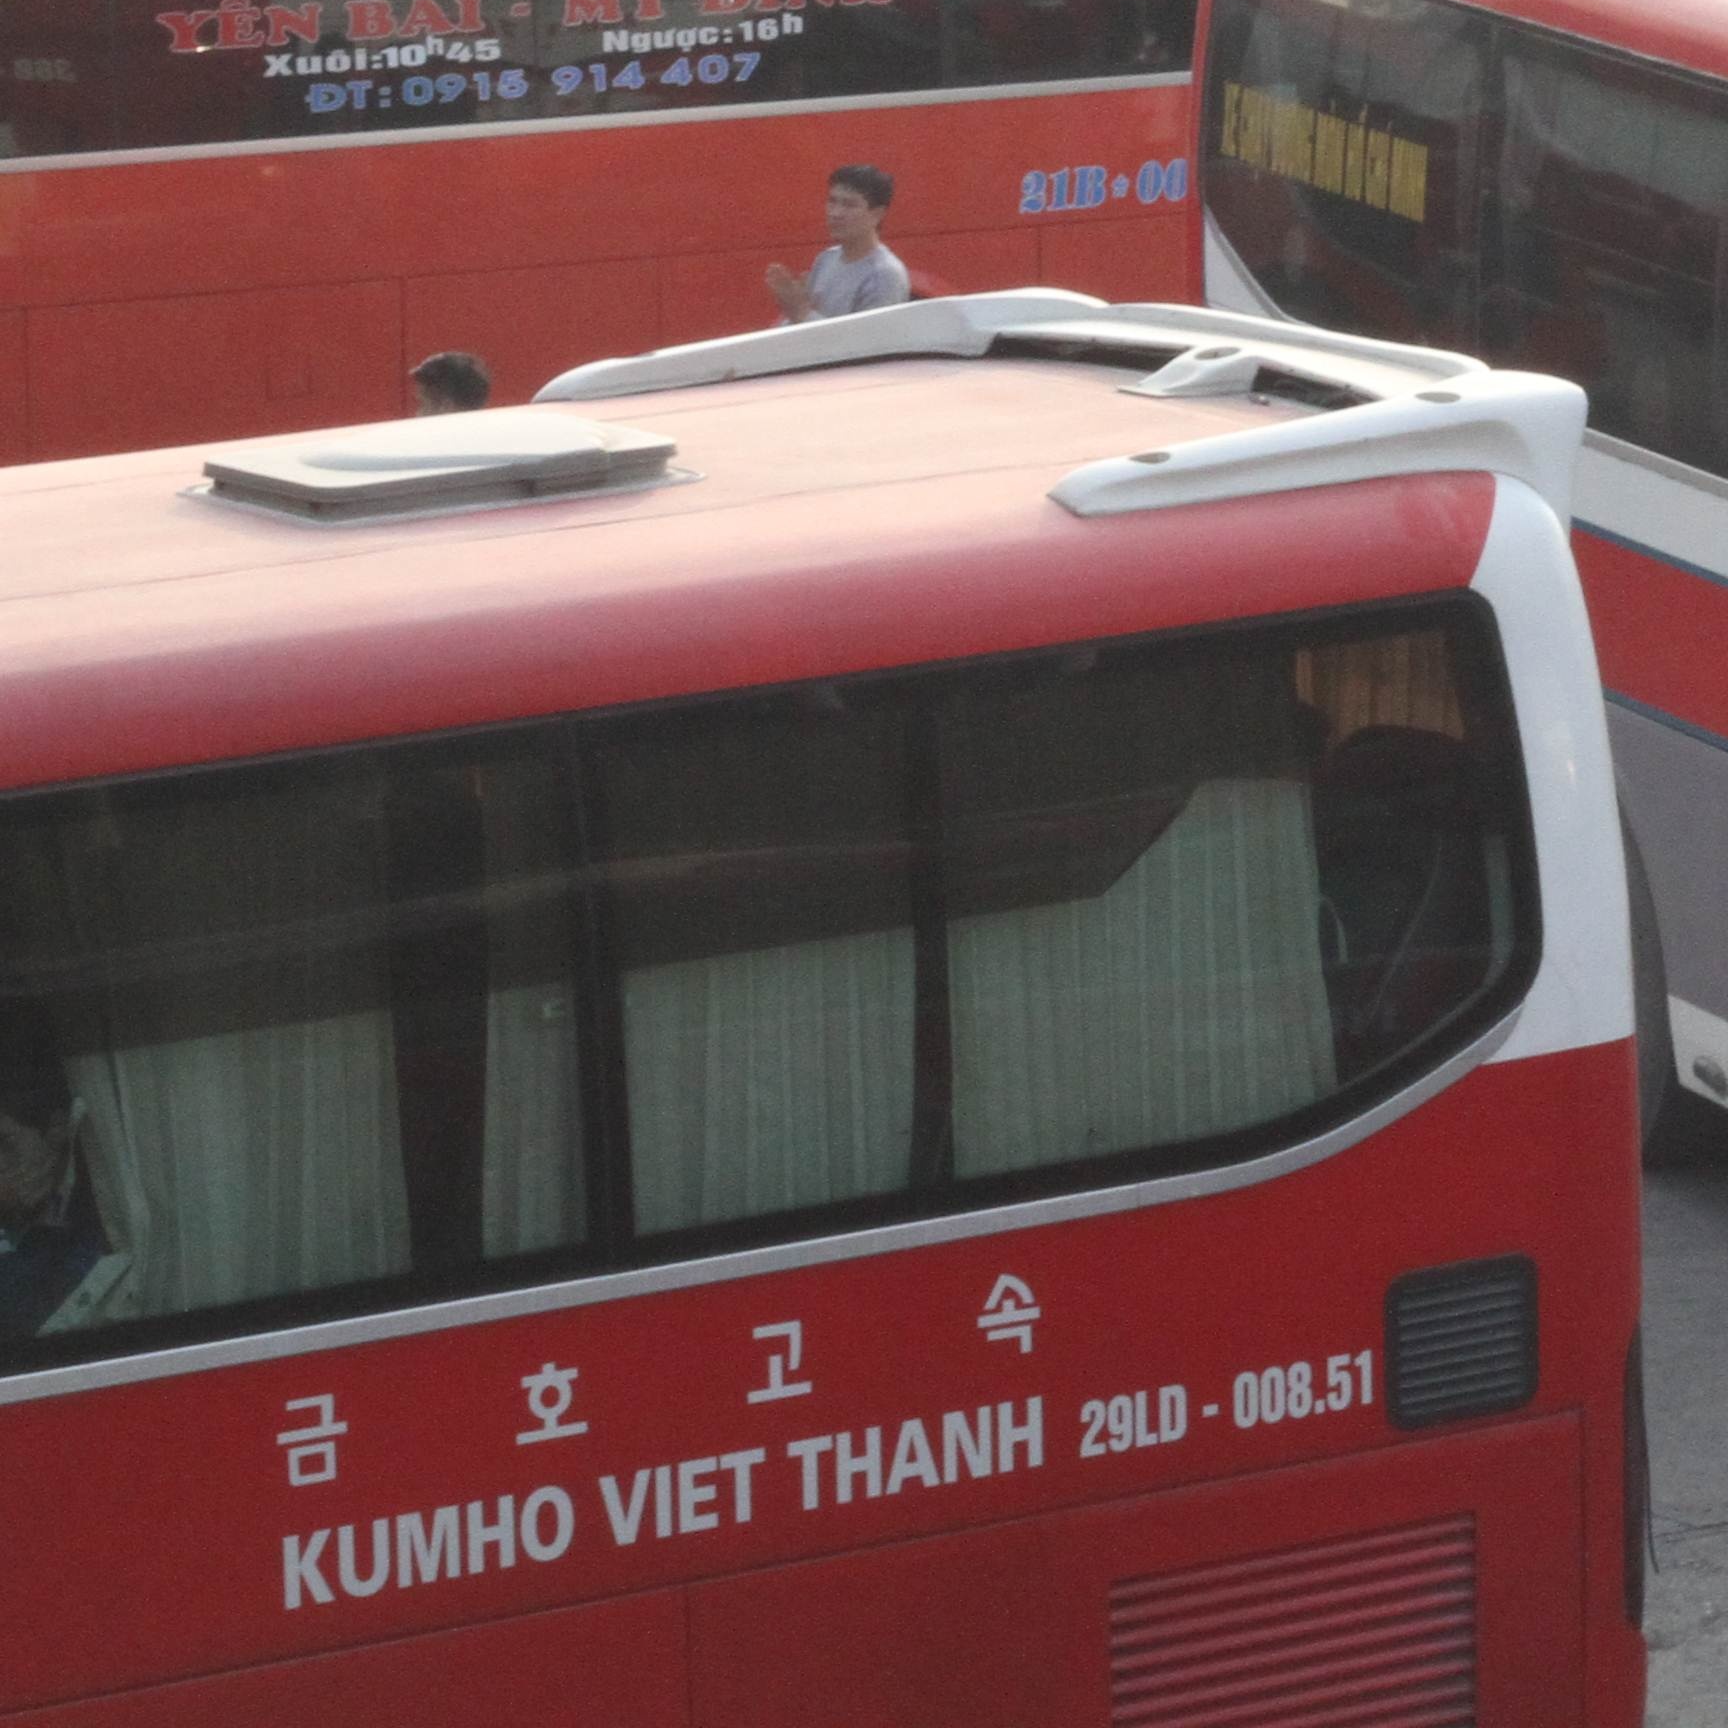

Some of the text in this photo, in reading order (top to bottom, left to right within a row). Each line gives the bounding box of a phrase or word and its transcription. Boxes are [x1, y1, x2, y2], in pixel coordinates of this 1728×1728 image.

[551, 51, 761, 97] 914 407
[280, 1347, 1375, 1611] KUMHO VIET THANH 29LD 008.51
